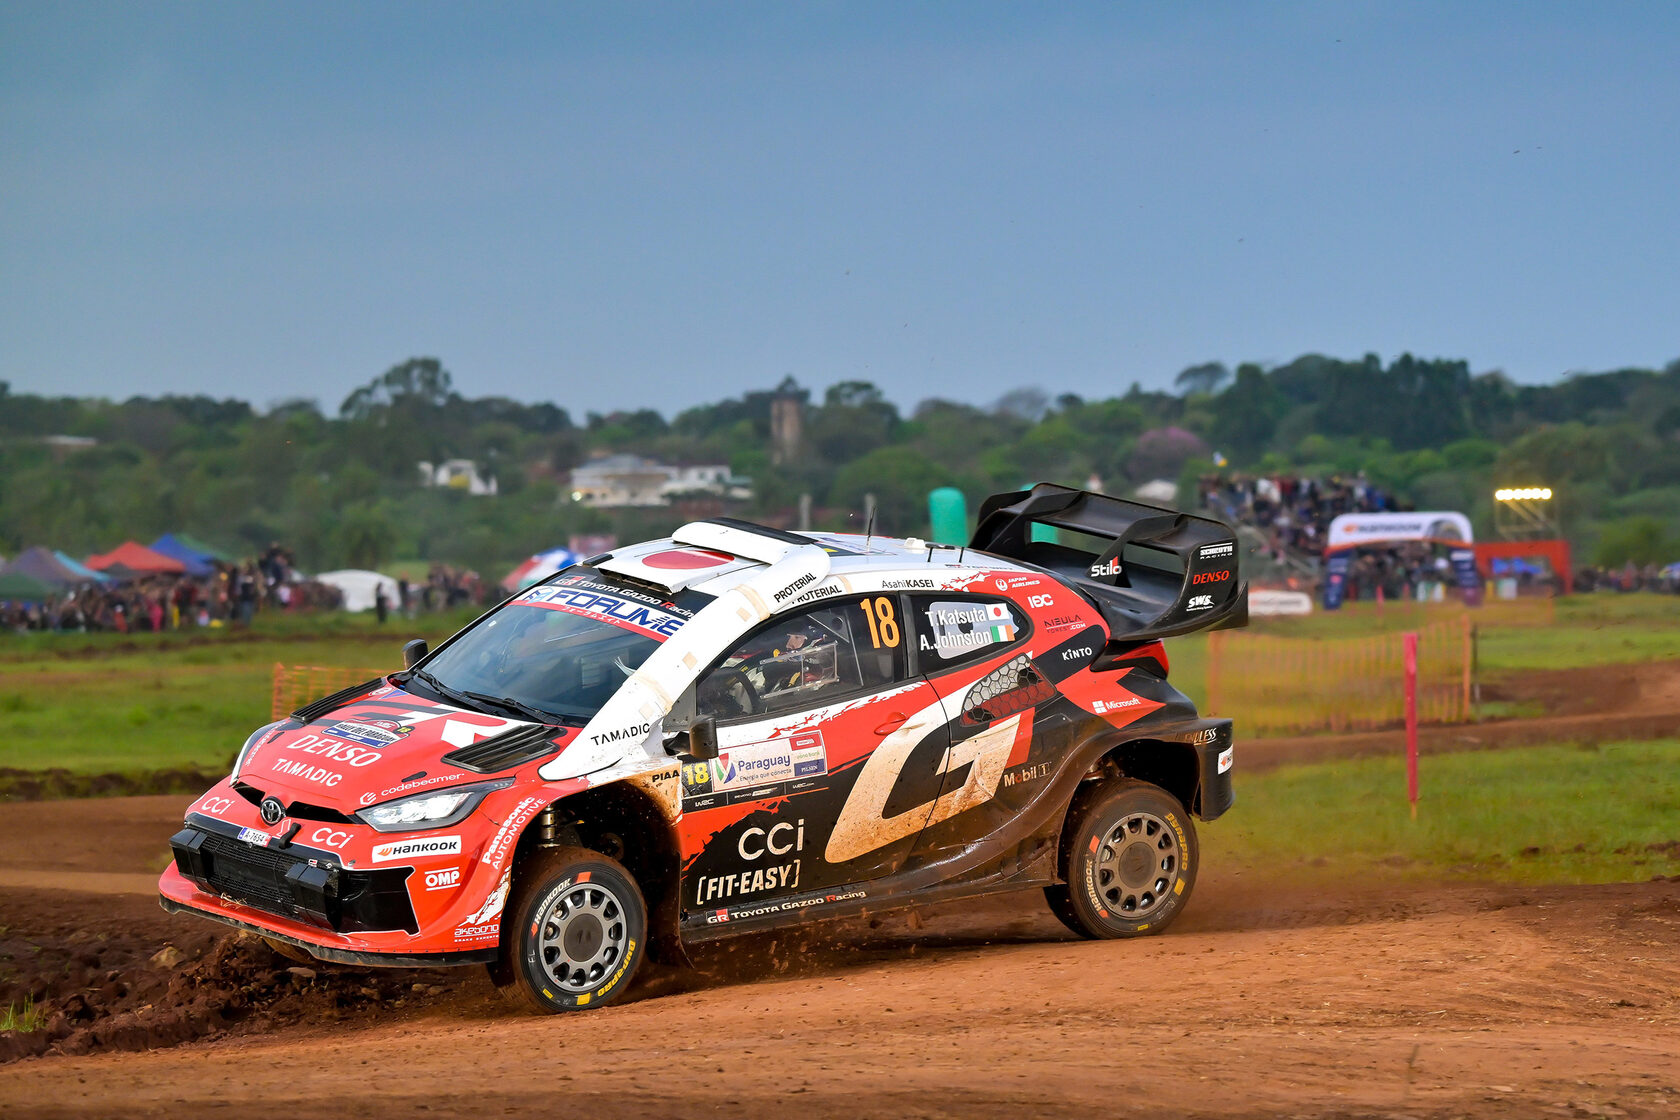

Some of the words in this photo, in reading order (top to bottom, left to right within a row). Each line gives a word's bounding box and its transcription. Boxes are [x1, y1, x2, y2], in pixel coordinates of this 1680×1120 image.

[1091, 556, 1123, 577] Stilo
[1192, 570, 1230, 585] DENSO
[773, 572, 817, 603] PROTERIAL
[1011, 580, 1041, 588] AIRLINES
[577, 580, 621, 593] TOYOTA
[660, 601, 694, 618] Racin
[860, 596, 900, 649] 18
[1105, 697, 1142, 710] Microsoft
[590, 723, 650, 746] TAMADIC
[287, 734, 383, 768] DENSO
[272, 758, 343, 787] TAMADIC
[682, 763, 710, 786] 18
[738, 754, 791, 772] Paraguay
[381, 773, 461, 797] codebeamer
[652, 769, 680, 783] PIAA
[1003, 765, 1037, 788] Mobil
[481, 797, 535, 865] Panasonic
[492, 798, 546, 870] AUTOMOTIVE
[425, 870, 460, 887] OMP
[731, 905, 780, 920] TOYOTA
[826, 890, 867, 903] Racing
